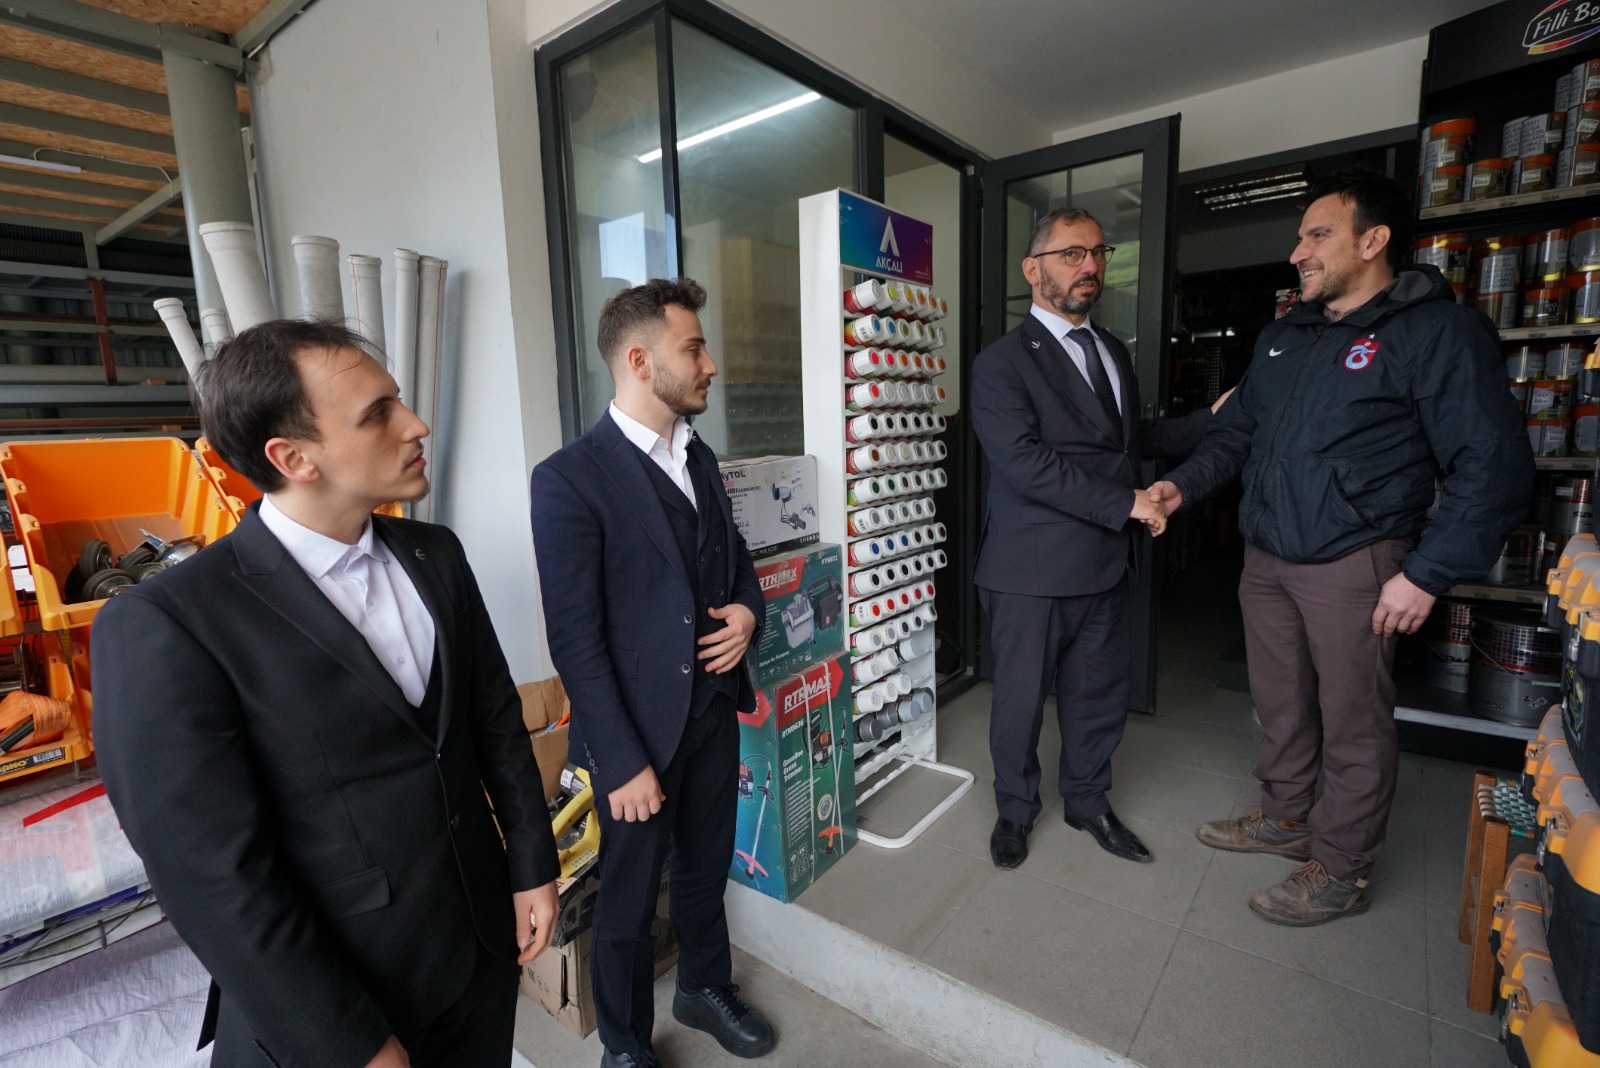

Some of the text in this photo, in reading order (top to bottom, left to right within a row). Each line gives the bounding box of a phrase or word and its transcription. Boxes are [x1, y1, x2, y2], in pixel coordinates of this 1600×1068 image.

[1533, 2, 1600, 39] Filli Bo
[875, 255, 903, 273] AKÇALI
[758, 567, 797, 588] RTRMAX
[784, 672, 832, 710] RTRMAX
